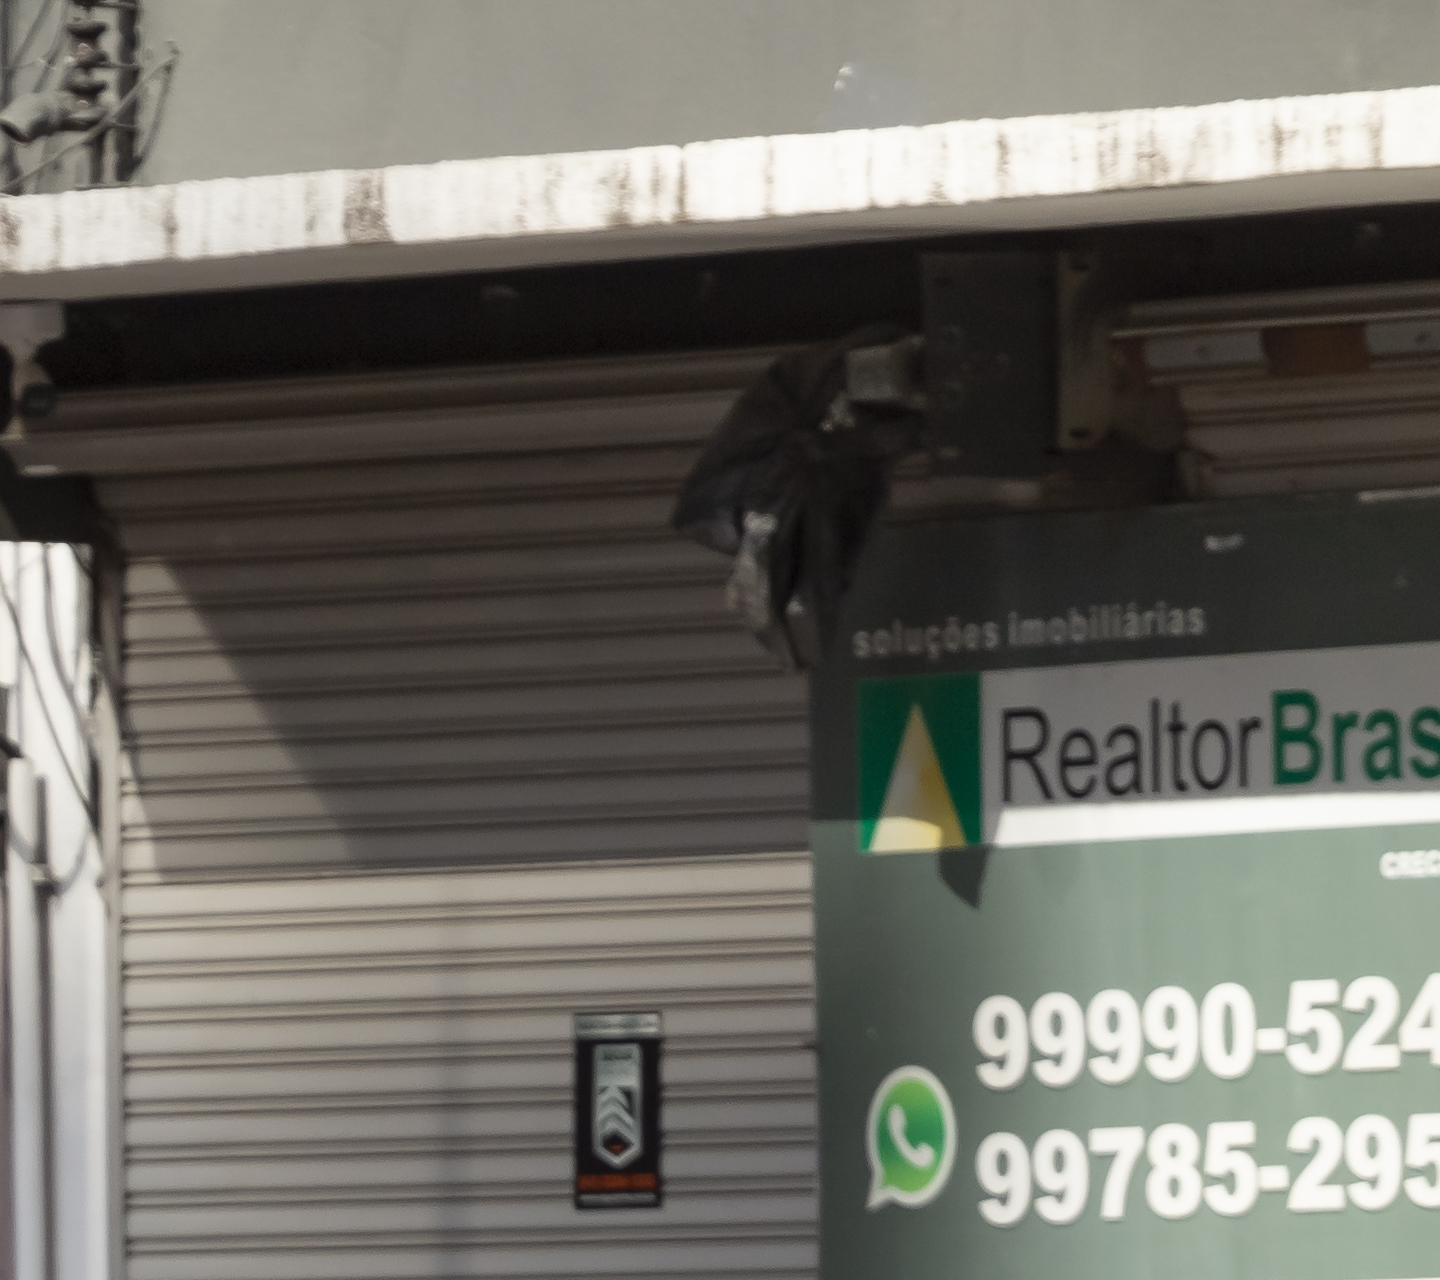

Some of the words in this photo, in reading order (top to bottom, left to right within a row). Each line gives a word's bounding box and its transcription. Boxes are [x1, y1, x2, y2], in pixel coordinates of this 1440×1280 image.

[852, 616, 999, 660] soluções
[1007, 602, 1206, 647] imobiliárias
[974, 974, 1440, 1090] 99990-524
[976, 1113, 1440, 1227] 99785-295
